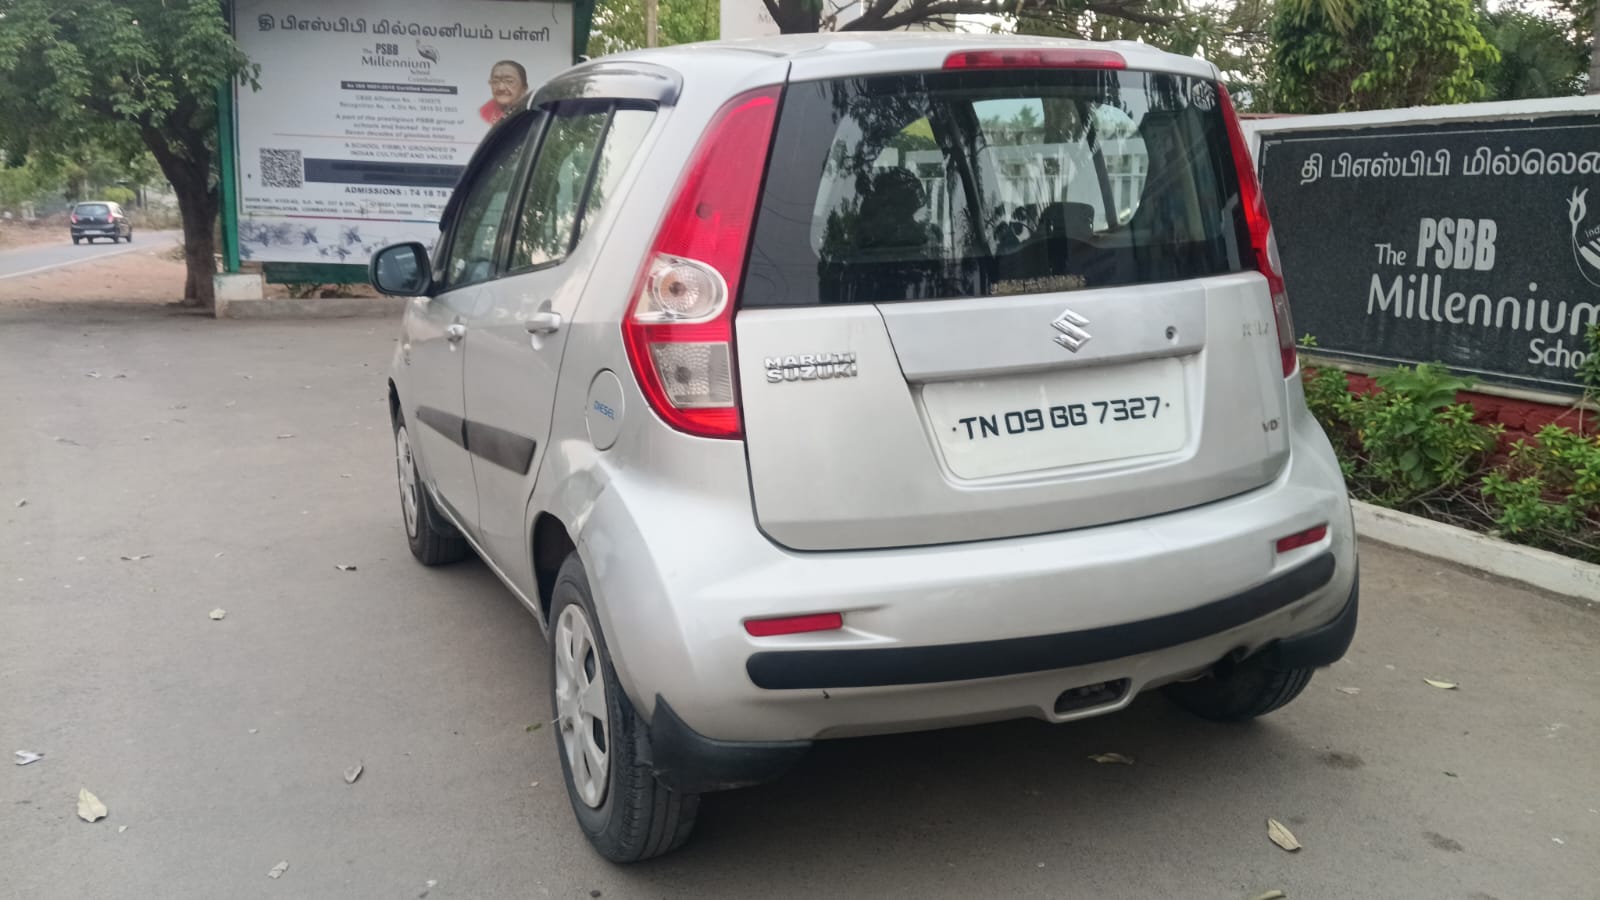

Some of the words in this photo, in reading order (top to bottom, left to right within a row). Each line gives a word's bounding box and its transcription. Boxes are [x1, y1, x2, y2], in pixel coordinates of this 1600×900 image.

[281, 14, 367, 34] பிஎஸ்பிபி
[372, 19, 494, 40] மில்லெனியம்
[499, 26, 550, 42] பள்ளி
[375, 43, 399, 56] PSBB
[361, 55, 431, 69] Millennium
[1300, 152, 1323, 186] தி
[1330, 148, 1451, 178] பிஎஸ்பிபி
[345, 186, 402, 196] ADMISSIONS
[1374, 242, 1407, 266] The
[1416, 217, 1498, 272] PSBB
[764, 351, 857, 369] MARUTI
[1527, 338, 1595, 370] Scho
[766, 363, 858, 384] SUZUKI
[593, 400, 615, 421] DIESEL
[958, 414, 1000, 441] TN
[1004, 408, 1045, 435] 09
[1091, 396, 1161, 424] 7327
